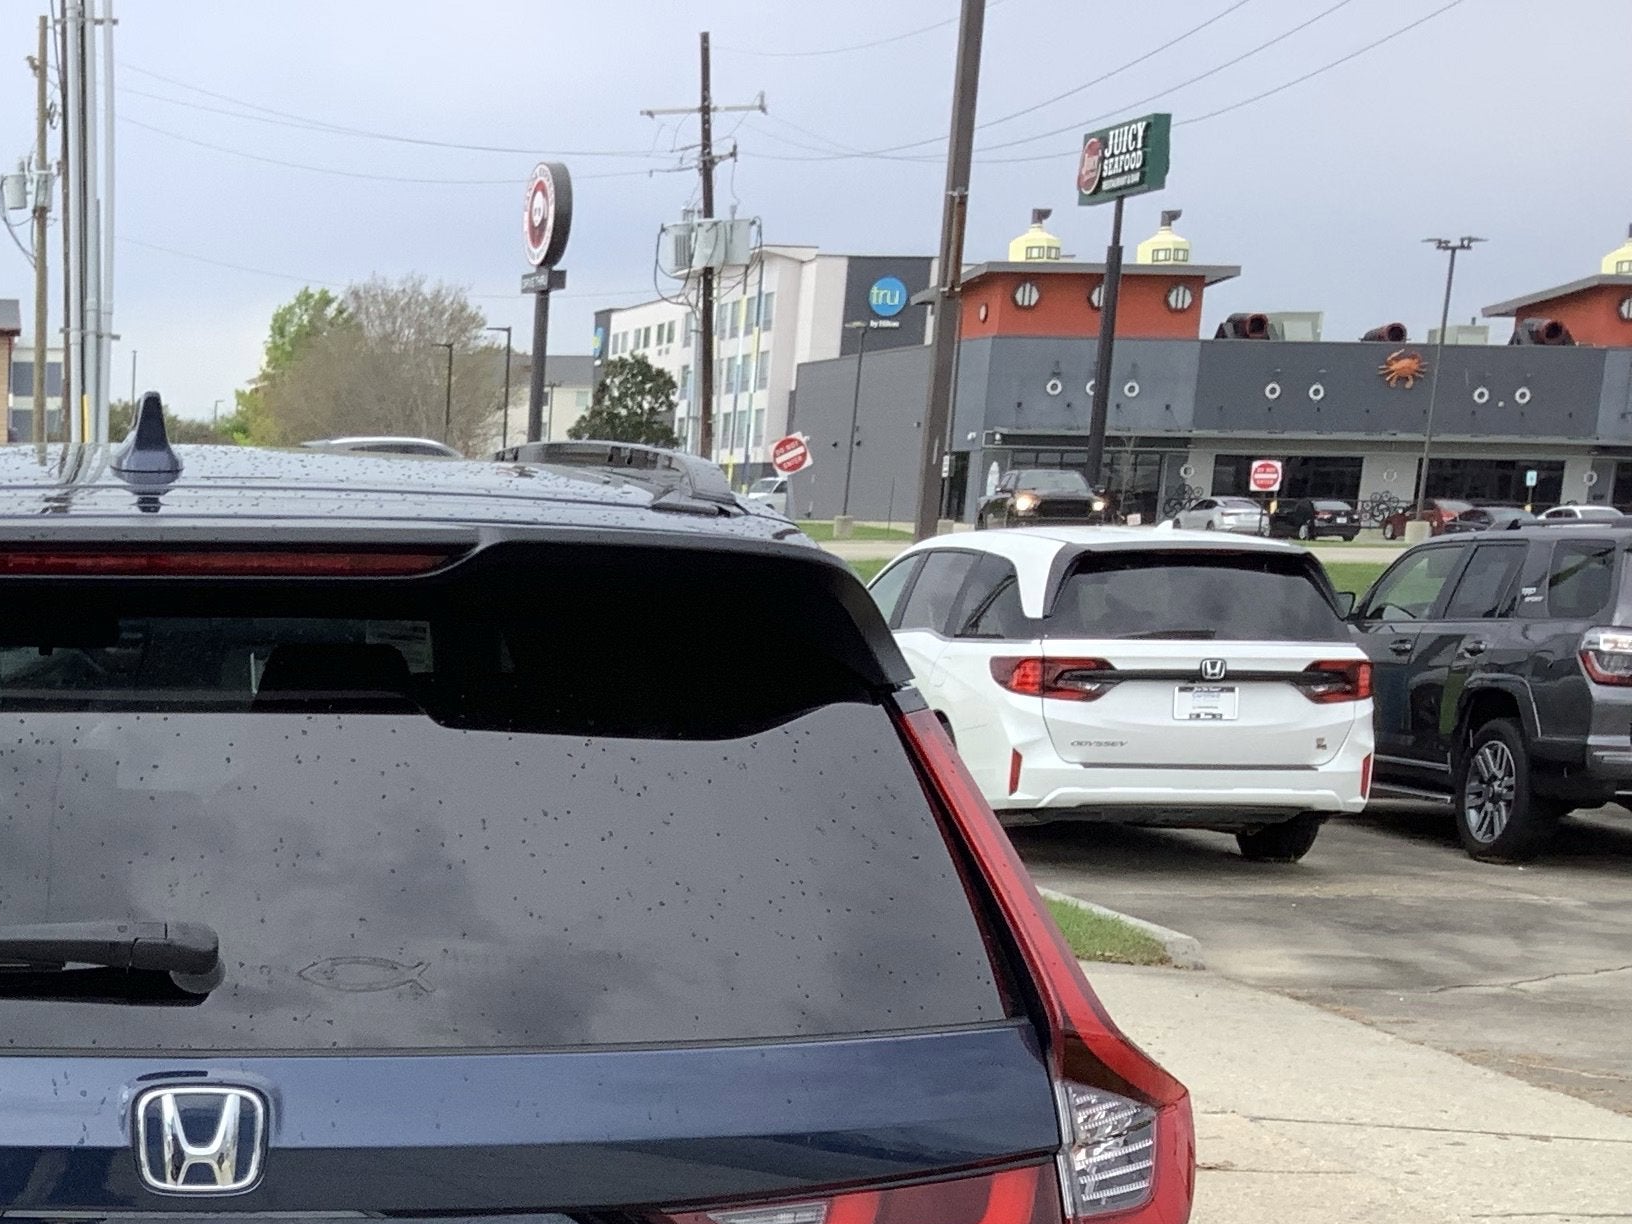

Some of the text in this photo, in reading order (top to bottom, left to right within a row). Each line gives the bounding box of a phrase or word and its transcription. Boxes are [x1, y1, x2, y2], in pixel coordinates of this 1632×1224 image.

[1104, 121, 1147, 157] JUICY
[1102, 150, 1143, 177] SEAFOOD
[870, 285, 899, 305] tru
